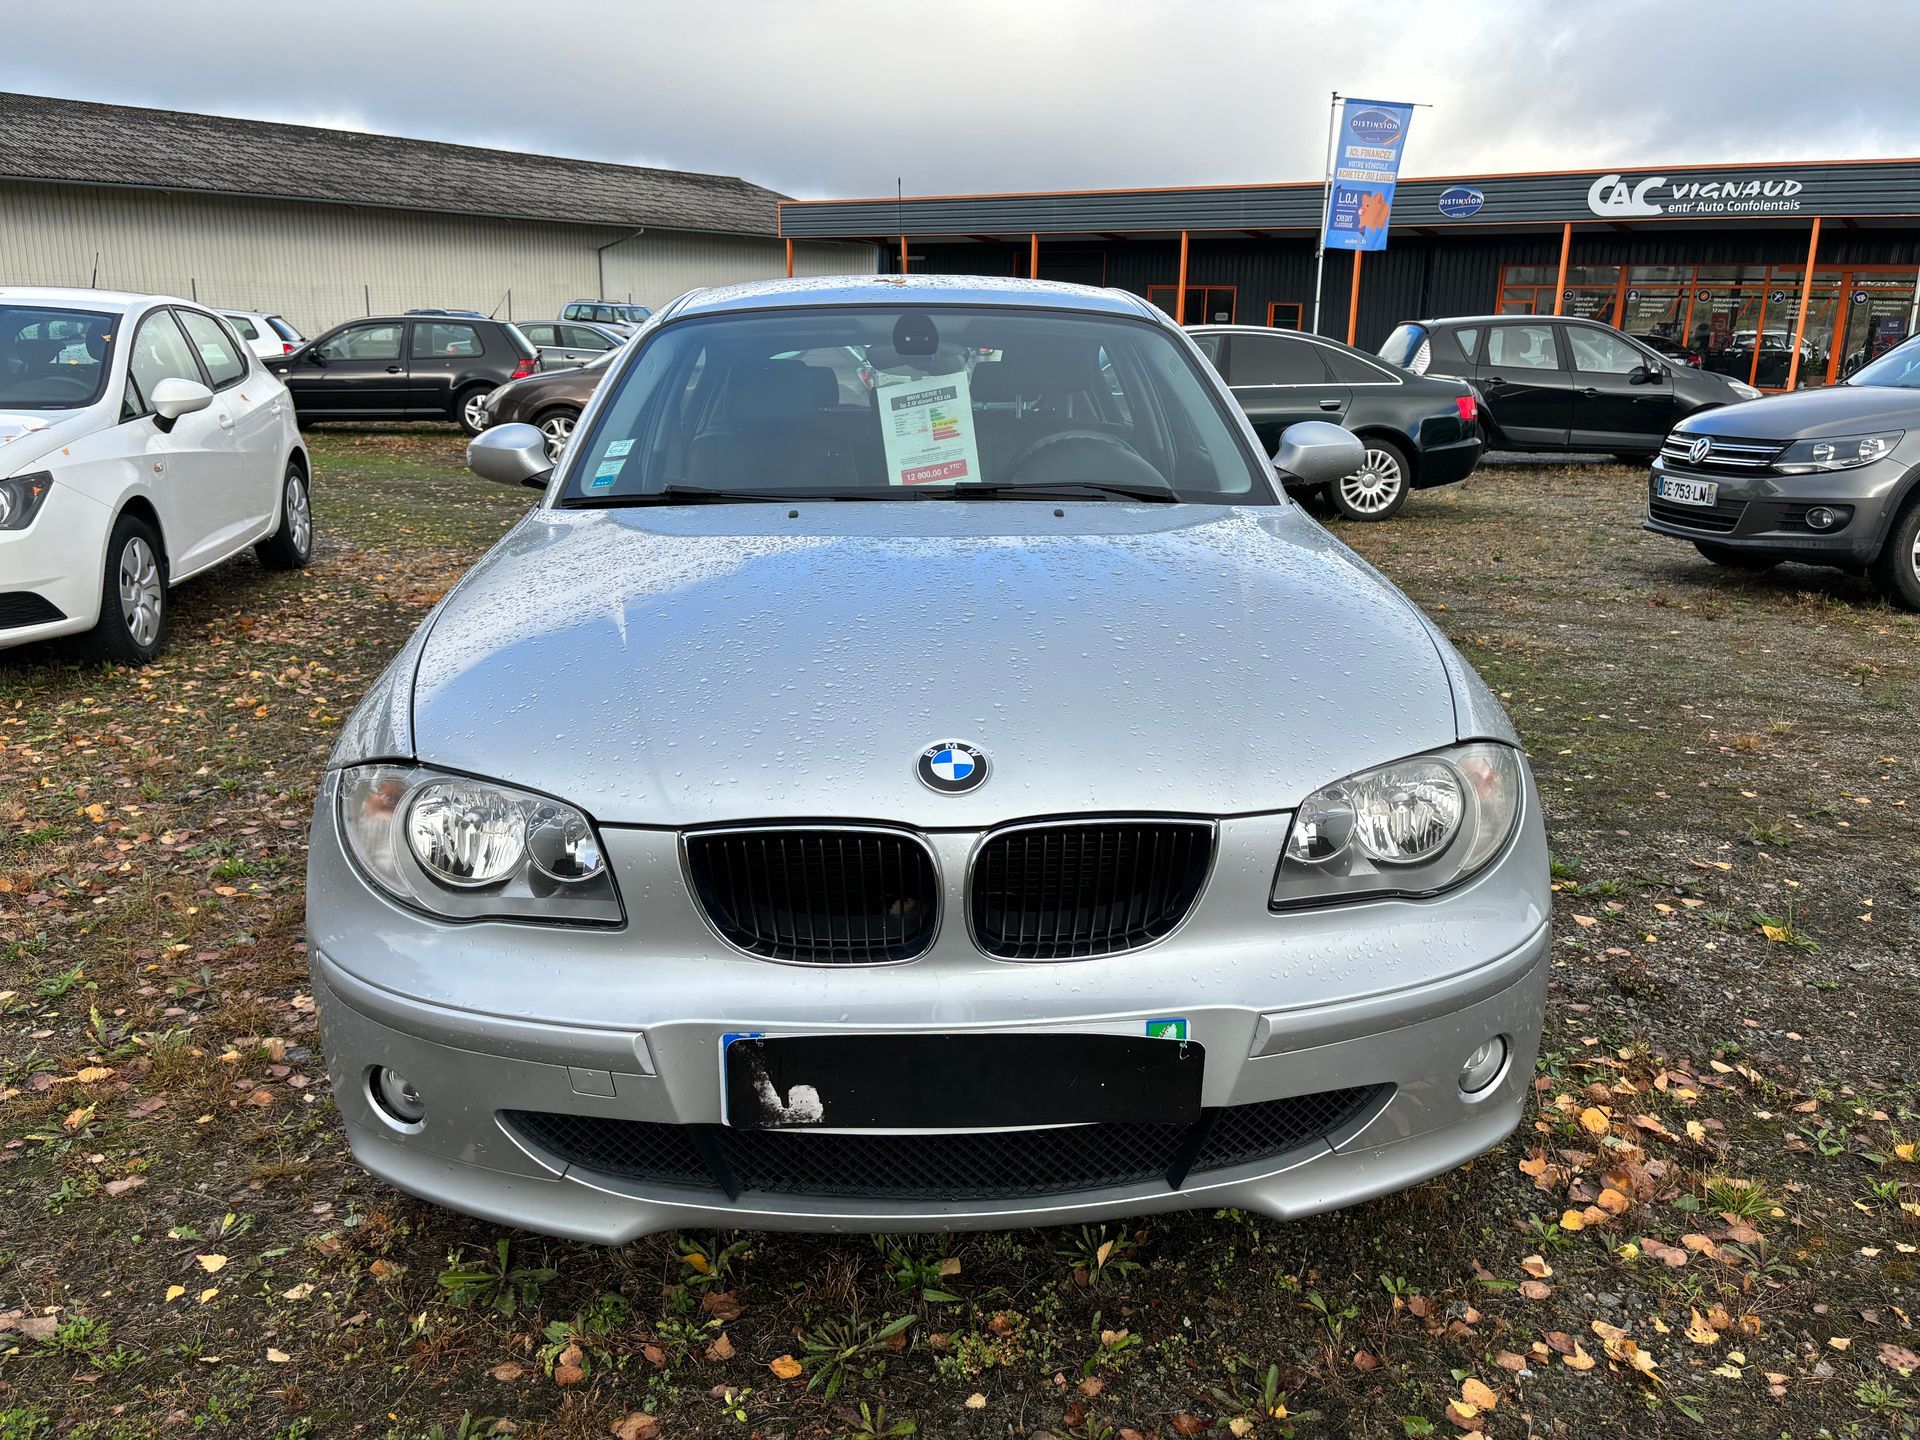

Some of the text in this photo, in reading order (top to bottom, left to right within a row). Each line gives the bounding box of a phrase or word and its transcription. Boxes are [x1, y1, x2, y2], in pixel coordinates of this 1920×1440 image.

[1352, 119, 1398, 130] DISTINXION
[1360, 149, 1392, 159] FINANCEZ
[1349, 160, 1364, 168] VOTRE
[1338, 170, 1395, 182] ACHETEZ OU LOUEZ
[1588, 174, 1668, 216] CAC
[1672, 180, 1803, 200] VIGNAUD
[1439, 196, 1482, 206] DISTINXION
[1697, 201, 1724, 212] Auto
[1727, 199, 1801, 212] Confolentais
[907, 472, 915, 481] 12
[943, 467, 949, 475] €
[1663, 481, 1707, 503] CE-753-LN
[924, 743, 982, 758] BMW
